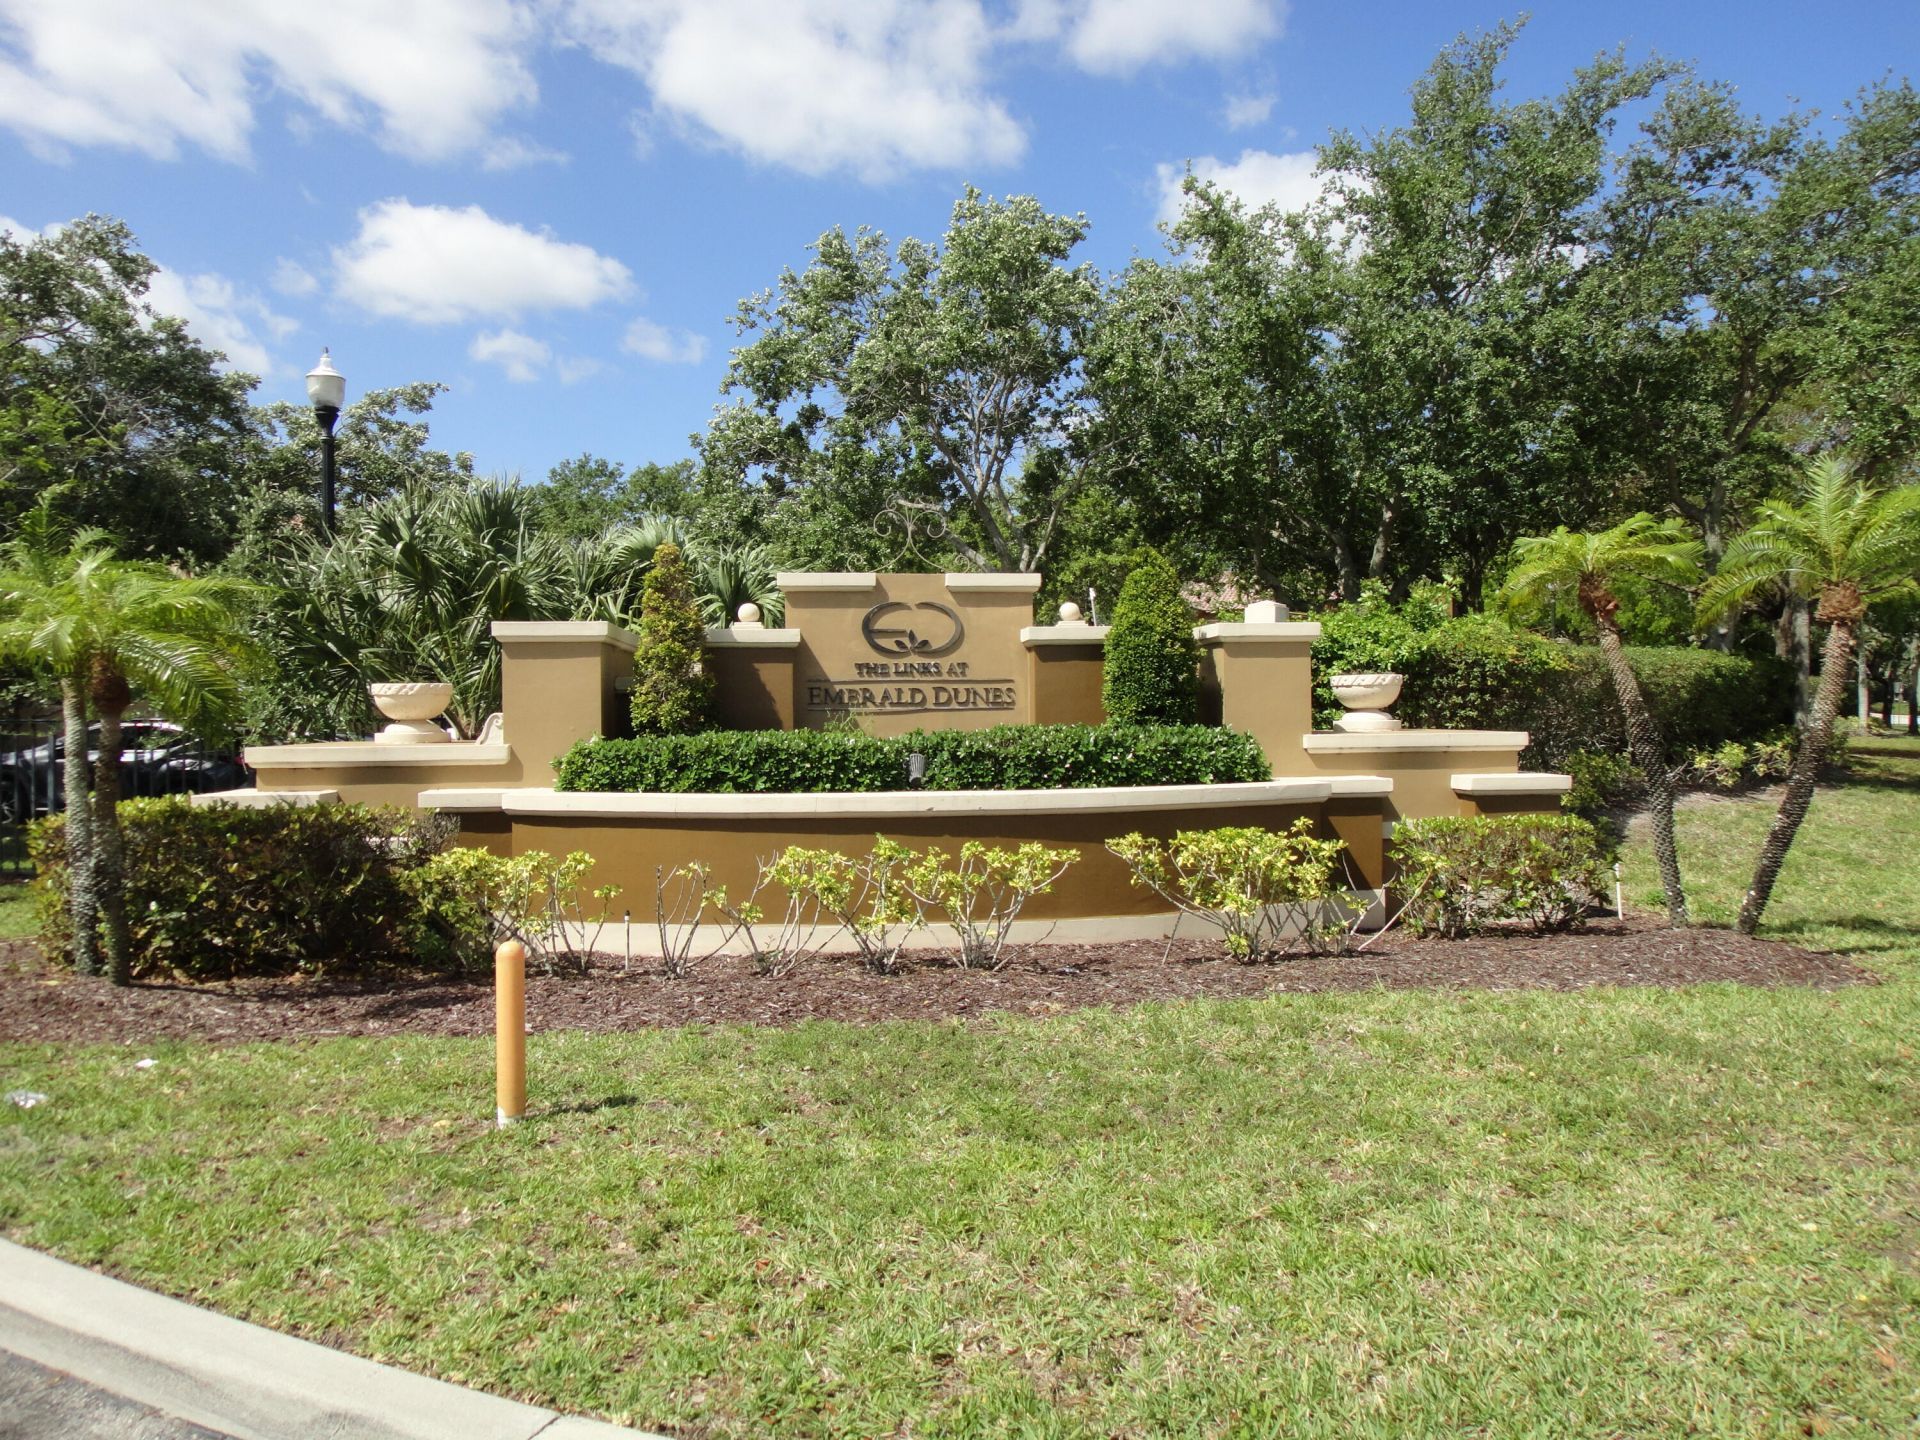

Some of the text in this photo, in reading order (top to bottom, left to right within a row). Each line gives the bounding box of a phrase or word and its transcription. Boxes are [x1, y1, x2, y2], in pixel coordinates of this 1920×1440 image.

[855, 662, 969, 676] THE LINKS AT
[807, 686, 1016, 708] EMERALD DUNES
